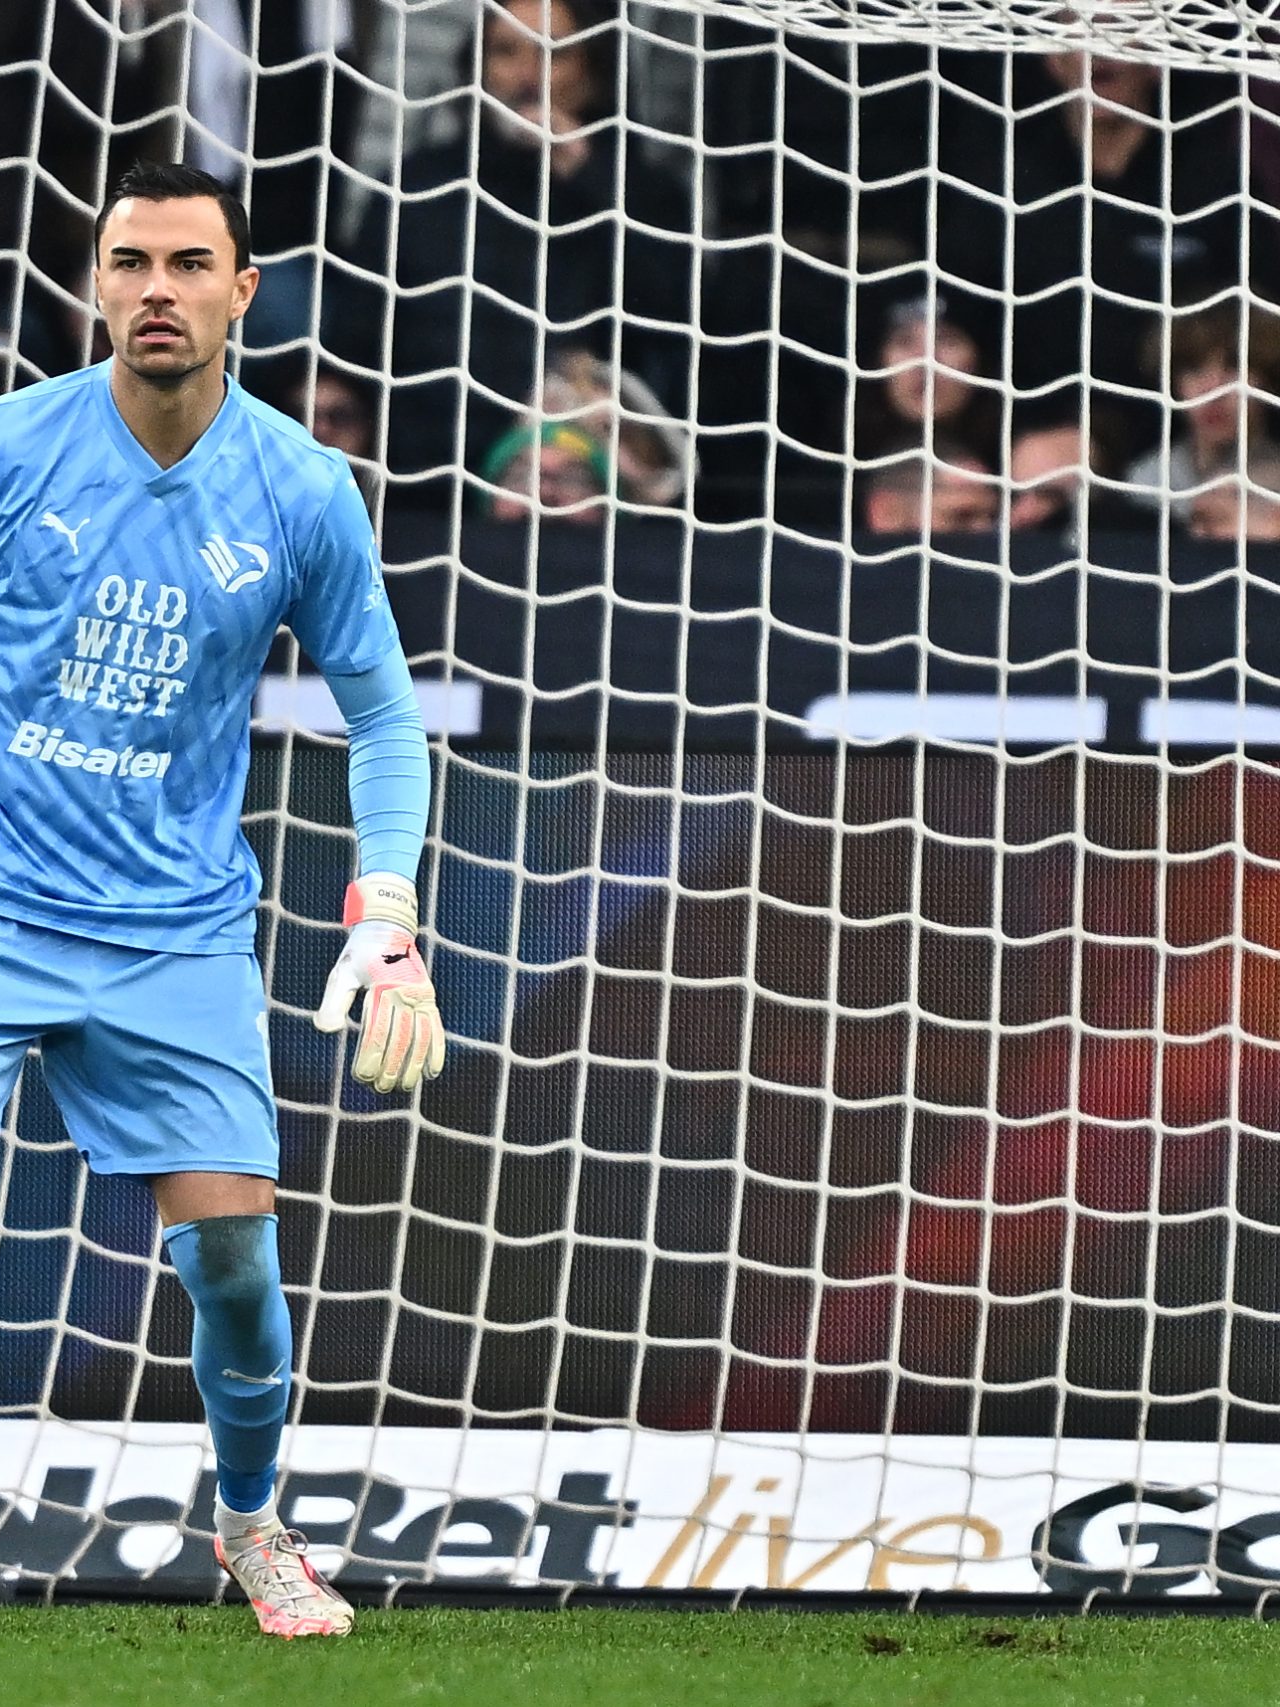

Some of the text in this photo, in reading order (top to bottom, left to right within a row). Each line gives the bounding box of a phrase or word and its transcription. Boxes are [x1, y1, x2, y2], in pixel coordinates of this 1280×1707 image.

[95, 574, 188, 629] OLD
[75, 616, 188, 674] WILD
[58, 658, 187, 717] WEST
[7, 720, 172, 780] Bisatel
[645, 1474, 1003, 1590] live
